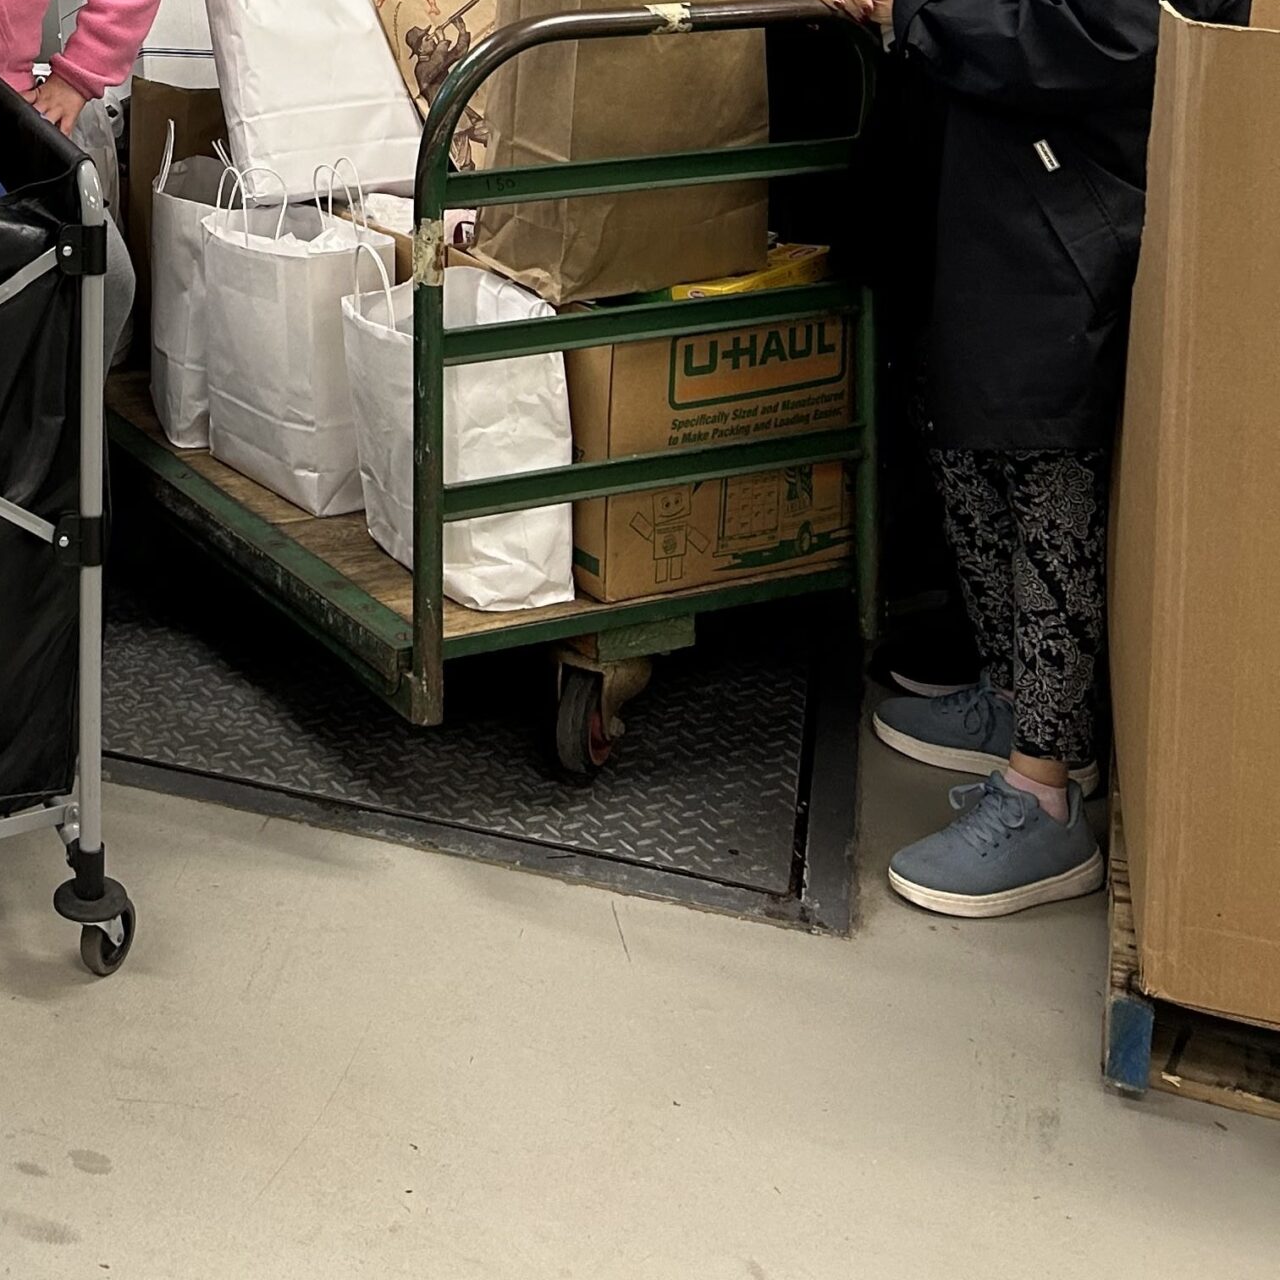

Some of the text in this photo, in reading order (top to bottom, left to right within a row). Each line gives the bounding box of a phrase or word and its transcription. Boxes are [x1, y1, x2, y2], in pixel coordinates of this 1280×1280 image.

[683, 322, 836, 378] U-HAUL
[671, 410, 731, 432] Specifically
[731, 405, 758, 421] Sized
[760, 403, 779, 416] and
[668, 433, 679, 446] to
[681, 430, 710, 445] Make
[711, 423, 751, 439] Packing
[752, 420, 772, 433] and
